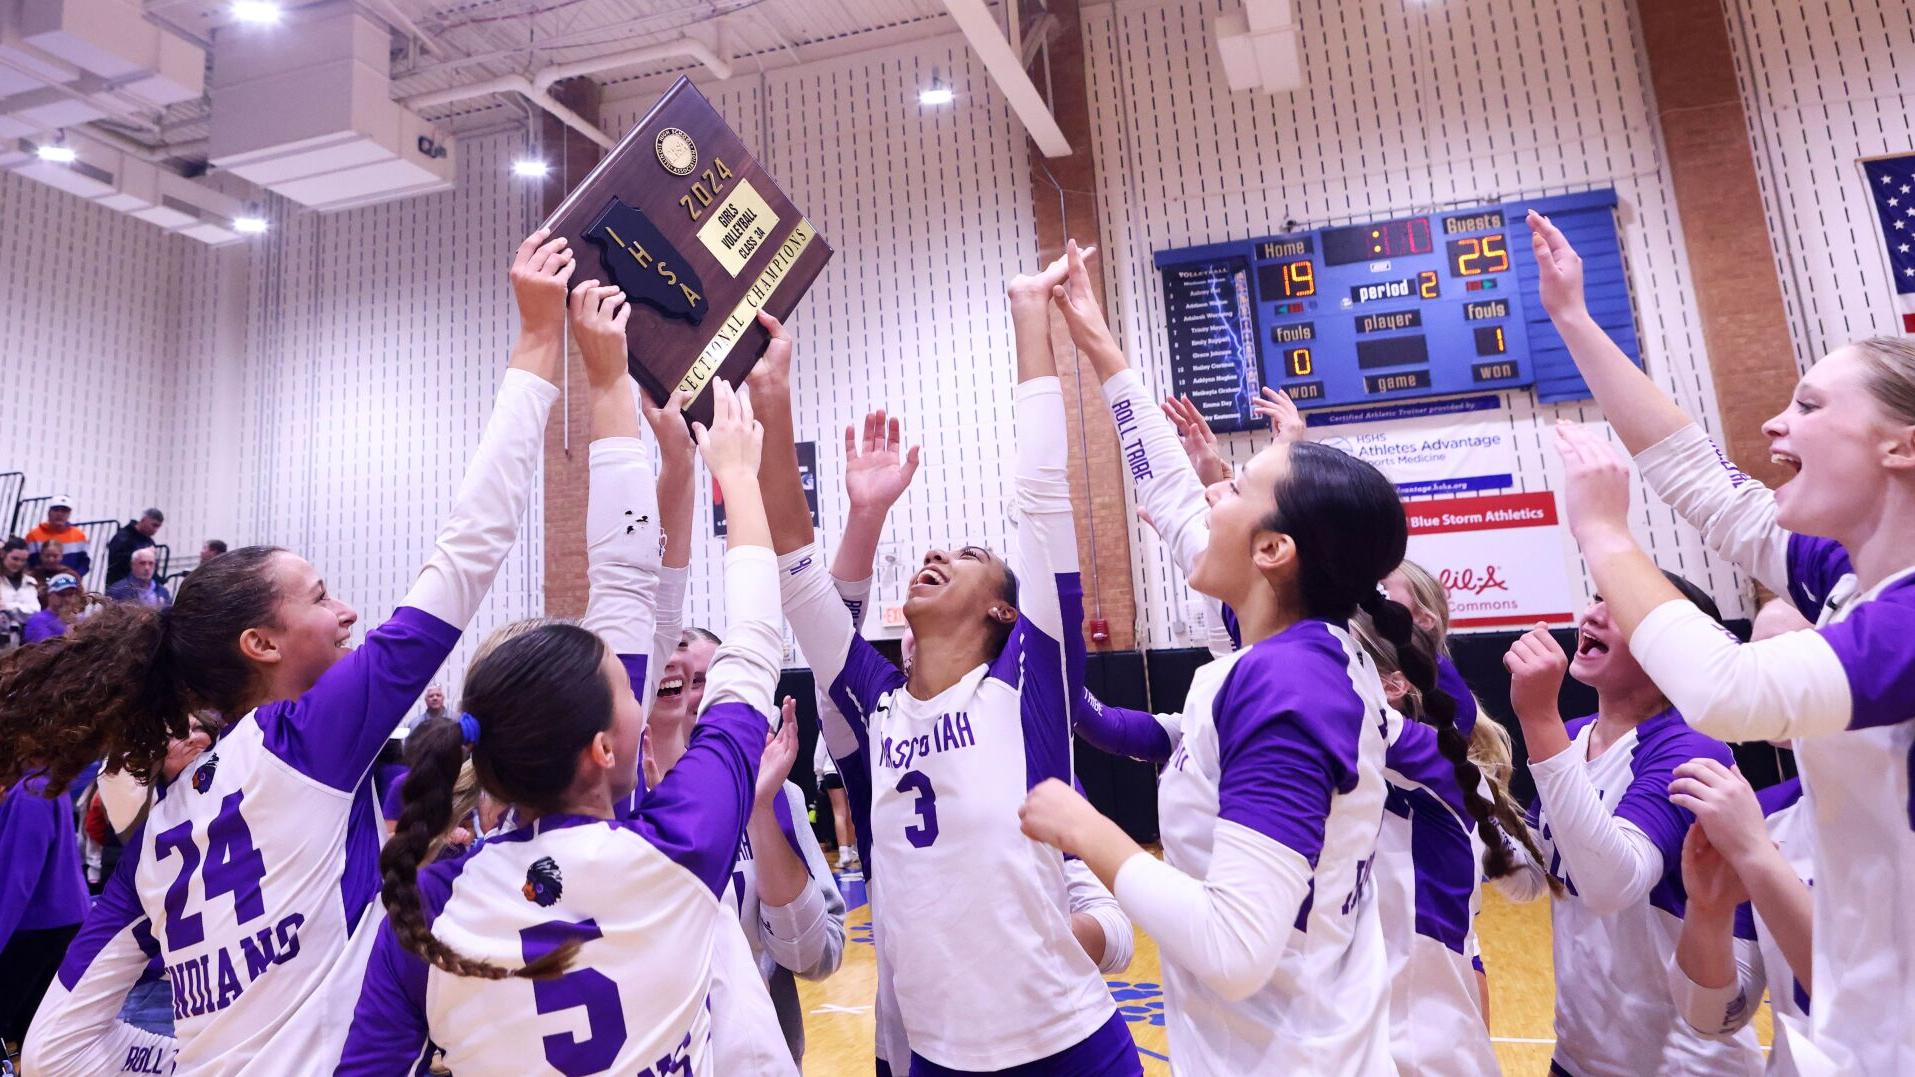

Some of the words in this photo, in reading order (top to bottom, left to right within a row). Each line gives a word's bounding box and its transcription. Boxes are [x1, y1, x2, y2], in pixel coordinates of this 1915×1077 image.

[679, 157, 733, 221] 2024
[718, 203, 739, 229] GIRLS
[1446, 214, 1501, 234] Guests
[721, 207, 758, 251] VOLLEYBALL
[738, 236, 758, 260] CLASS
[754, 226, 766, 240] 3A
[1264, 239, 1305, 259] Home
[746, 227, 808, 308] CHAMPIONS
[1458, 235, 1509, 276] 25
[1282, 261, 1315, 297] 19
[1359, 279, 1409, 302] period
[1420, 271, 1437, 299] 2
[1364, 312, 1413, 332] player
[1468, 301, 1506, 320] fouls
[1277, 325, 1311, 343] fouls
[1496, 328, 1504, 352] 1
[1294, 349, 1311, 376] 0
[1480, 363, 1511, 379] won
[1288, 382, 1318, 398] won
[1378, 373, 1416, 391] game
[1329, 412, 1364, 423] Certified
[1365, 409, 1397, 419] Athletic
[1398, 407, 1427, 416] Trainer
[1429, 403, 1464, 414] provided
[1465, 401, 1476, 410] by
[1112, 399, 1137, 440] ROLL
[1125, 438, 1153, 484] TRIBE
[1357, 433, 1387, 444] HSHS
[1359, 442, 1417, 457] Athletes
[1421, 435, 1502, 452] Advantage
[1398, 453, 1446, 465] Medicine
[1410, 515, 1440, 528] Blue
[1442, 513, 1483, 526] Storm
[1485, 508, 1544, 522] Athletics
[1448, 600, 1518, 613] Commons
[896, 770, 939, 849] 3
[154, 787, 267, 953] 24
[518, 918, 627, 1077] 5
[121, 1046, 163, 1074] ROLL
